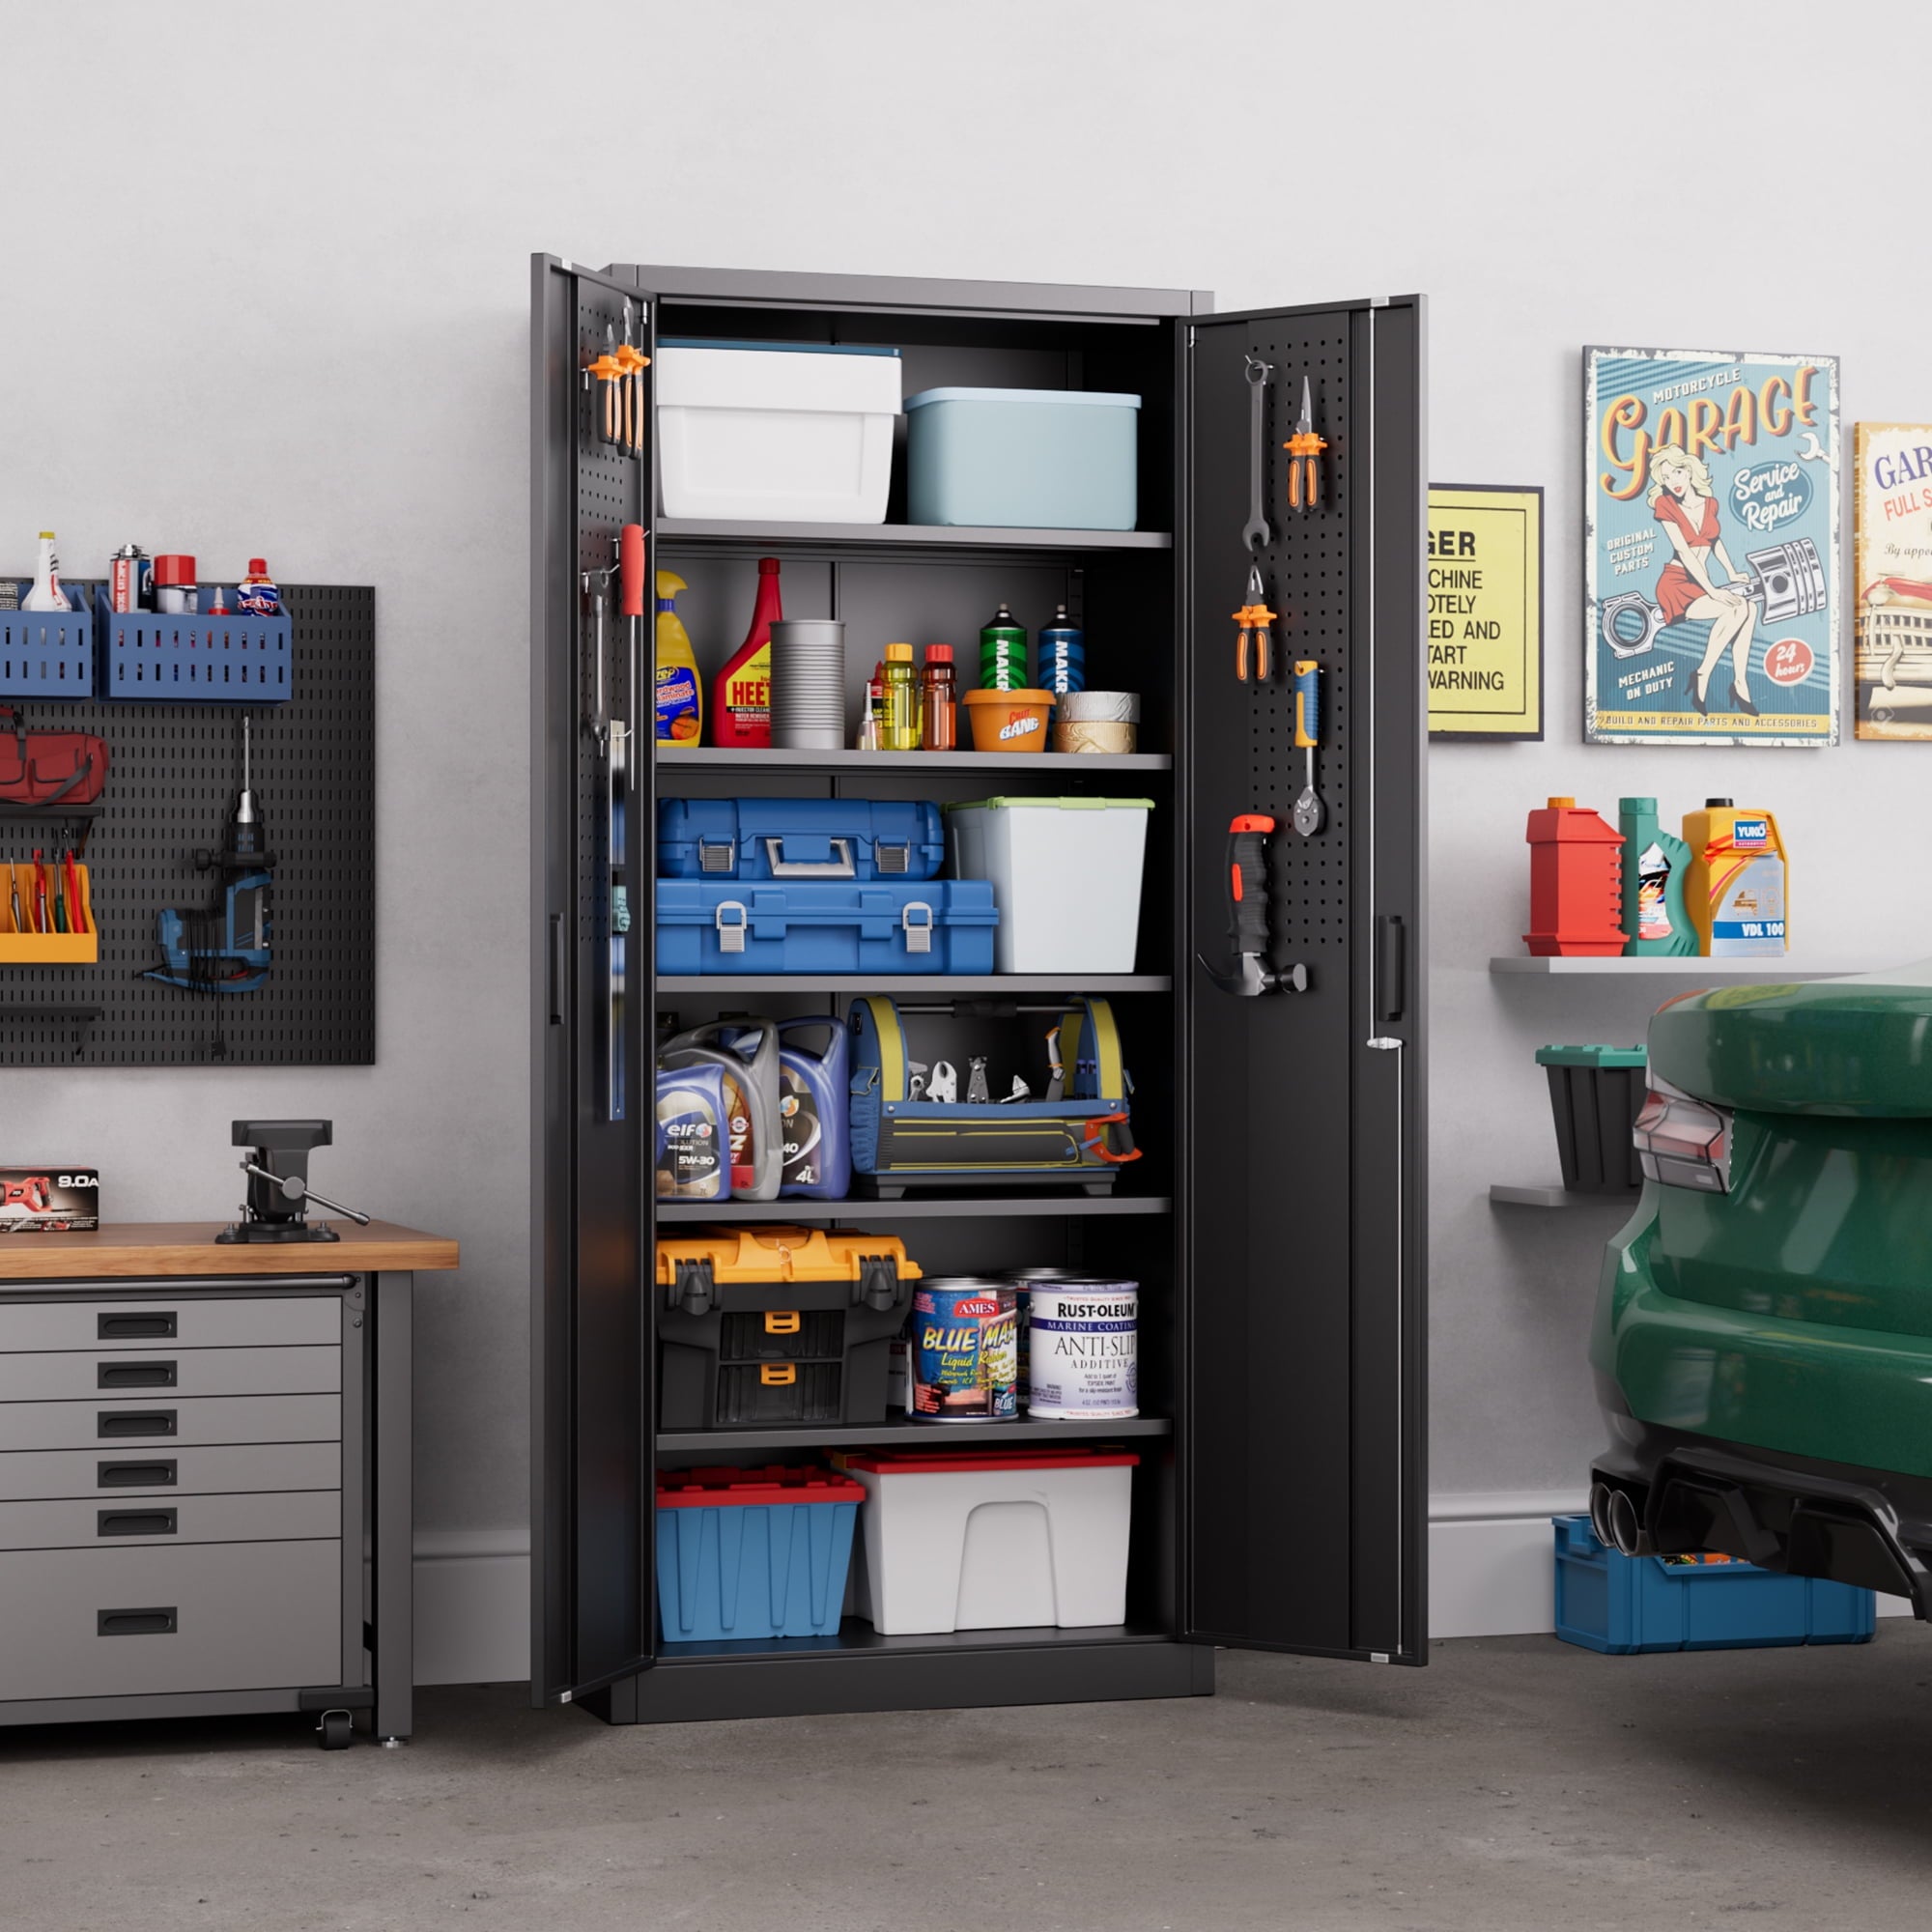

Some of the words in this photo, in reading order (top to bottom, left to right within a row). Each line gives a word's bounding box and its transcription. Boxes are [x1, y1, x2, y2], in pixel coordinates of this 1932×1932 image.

[1653, 367, 1742, 405] MOTORCYCLE
[1600, 366, 1819, 501] GARAGE
[1874, 445, 1932, 490] GAR
[1734, 462, 1800, 500] Service
[1764, 484, 1785, 502] and
[1742, 492, 1803, 531] Repair
[1884, 493, 1920, 522] FULL
[1606, 528, 1657, 551] ORIGINAL
[1609, 543, 1654, 564] CUSTOM
[1884, 542, 1901, 558] By
[1614, 557, 1649, 577] PARTS
[1429, 568, 1483, 589] CHINE
[1428, 619, 1454, 639] ED
[1463, 620, 1501, 639] AND
[1776, 642, 1797, 663] 24
[1618, 662, 1675, 689] MECHANIC
[1775, 663, 1805, 678] hours
[657, 680, 692, 695] rdwood
[1627, 686, 1641, 700] ON
[1645, 677, 1674, 696] DUTY
[999, 717, 1040, 741] BANG
[1605, 715, 1634, 725] BUILD
[1637, 716, 1657, 725] AND
[1661, 717, 1693, 726] REPAIR
[1697, 718, 1728, 726] PARTS
[1732, 718, 1751, 727] AND
[1754, 718, 1817, 728] ACCESSORIES
[1738, 823, 1767, 838] YUKO
[1742, 923, 1764, 938] VDL
[667, 1123, 696, 1137] elf
[678, 1155, 715, 1166] 5W-30
[58, 1175, 99, 1188] 9.0A
[795, 1169, 814, 1183] 4L
[959, 1303, 995, 1315] AMES
[1058, 1302, 1135, 1318] RUST-OLEUM
[1047, 1321, 1094, 1331] MARINE
[923, 1326, 980, 1352] BLUE
[1055, 1335, 1136, 1356] ANTI-SLIP
[941, 1352, 974, 1371] Liquid
[1071, 1358, 1128, 1369] ADDITIVE
